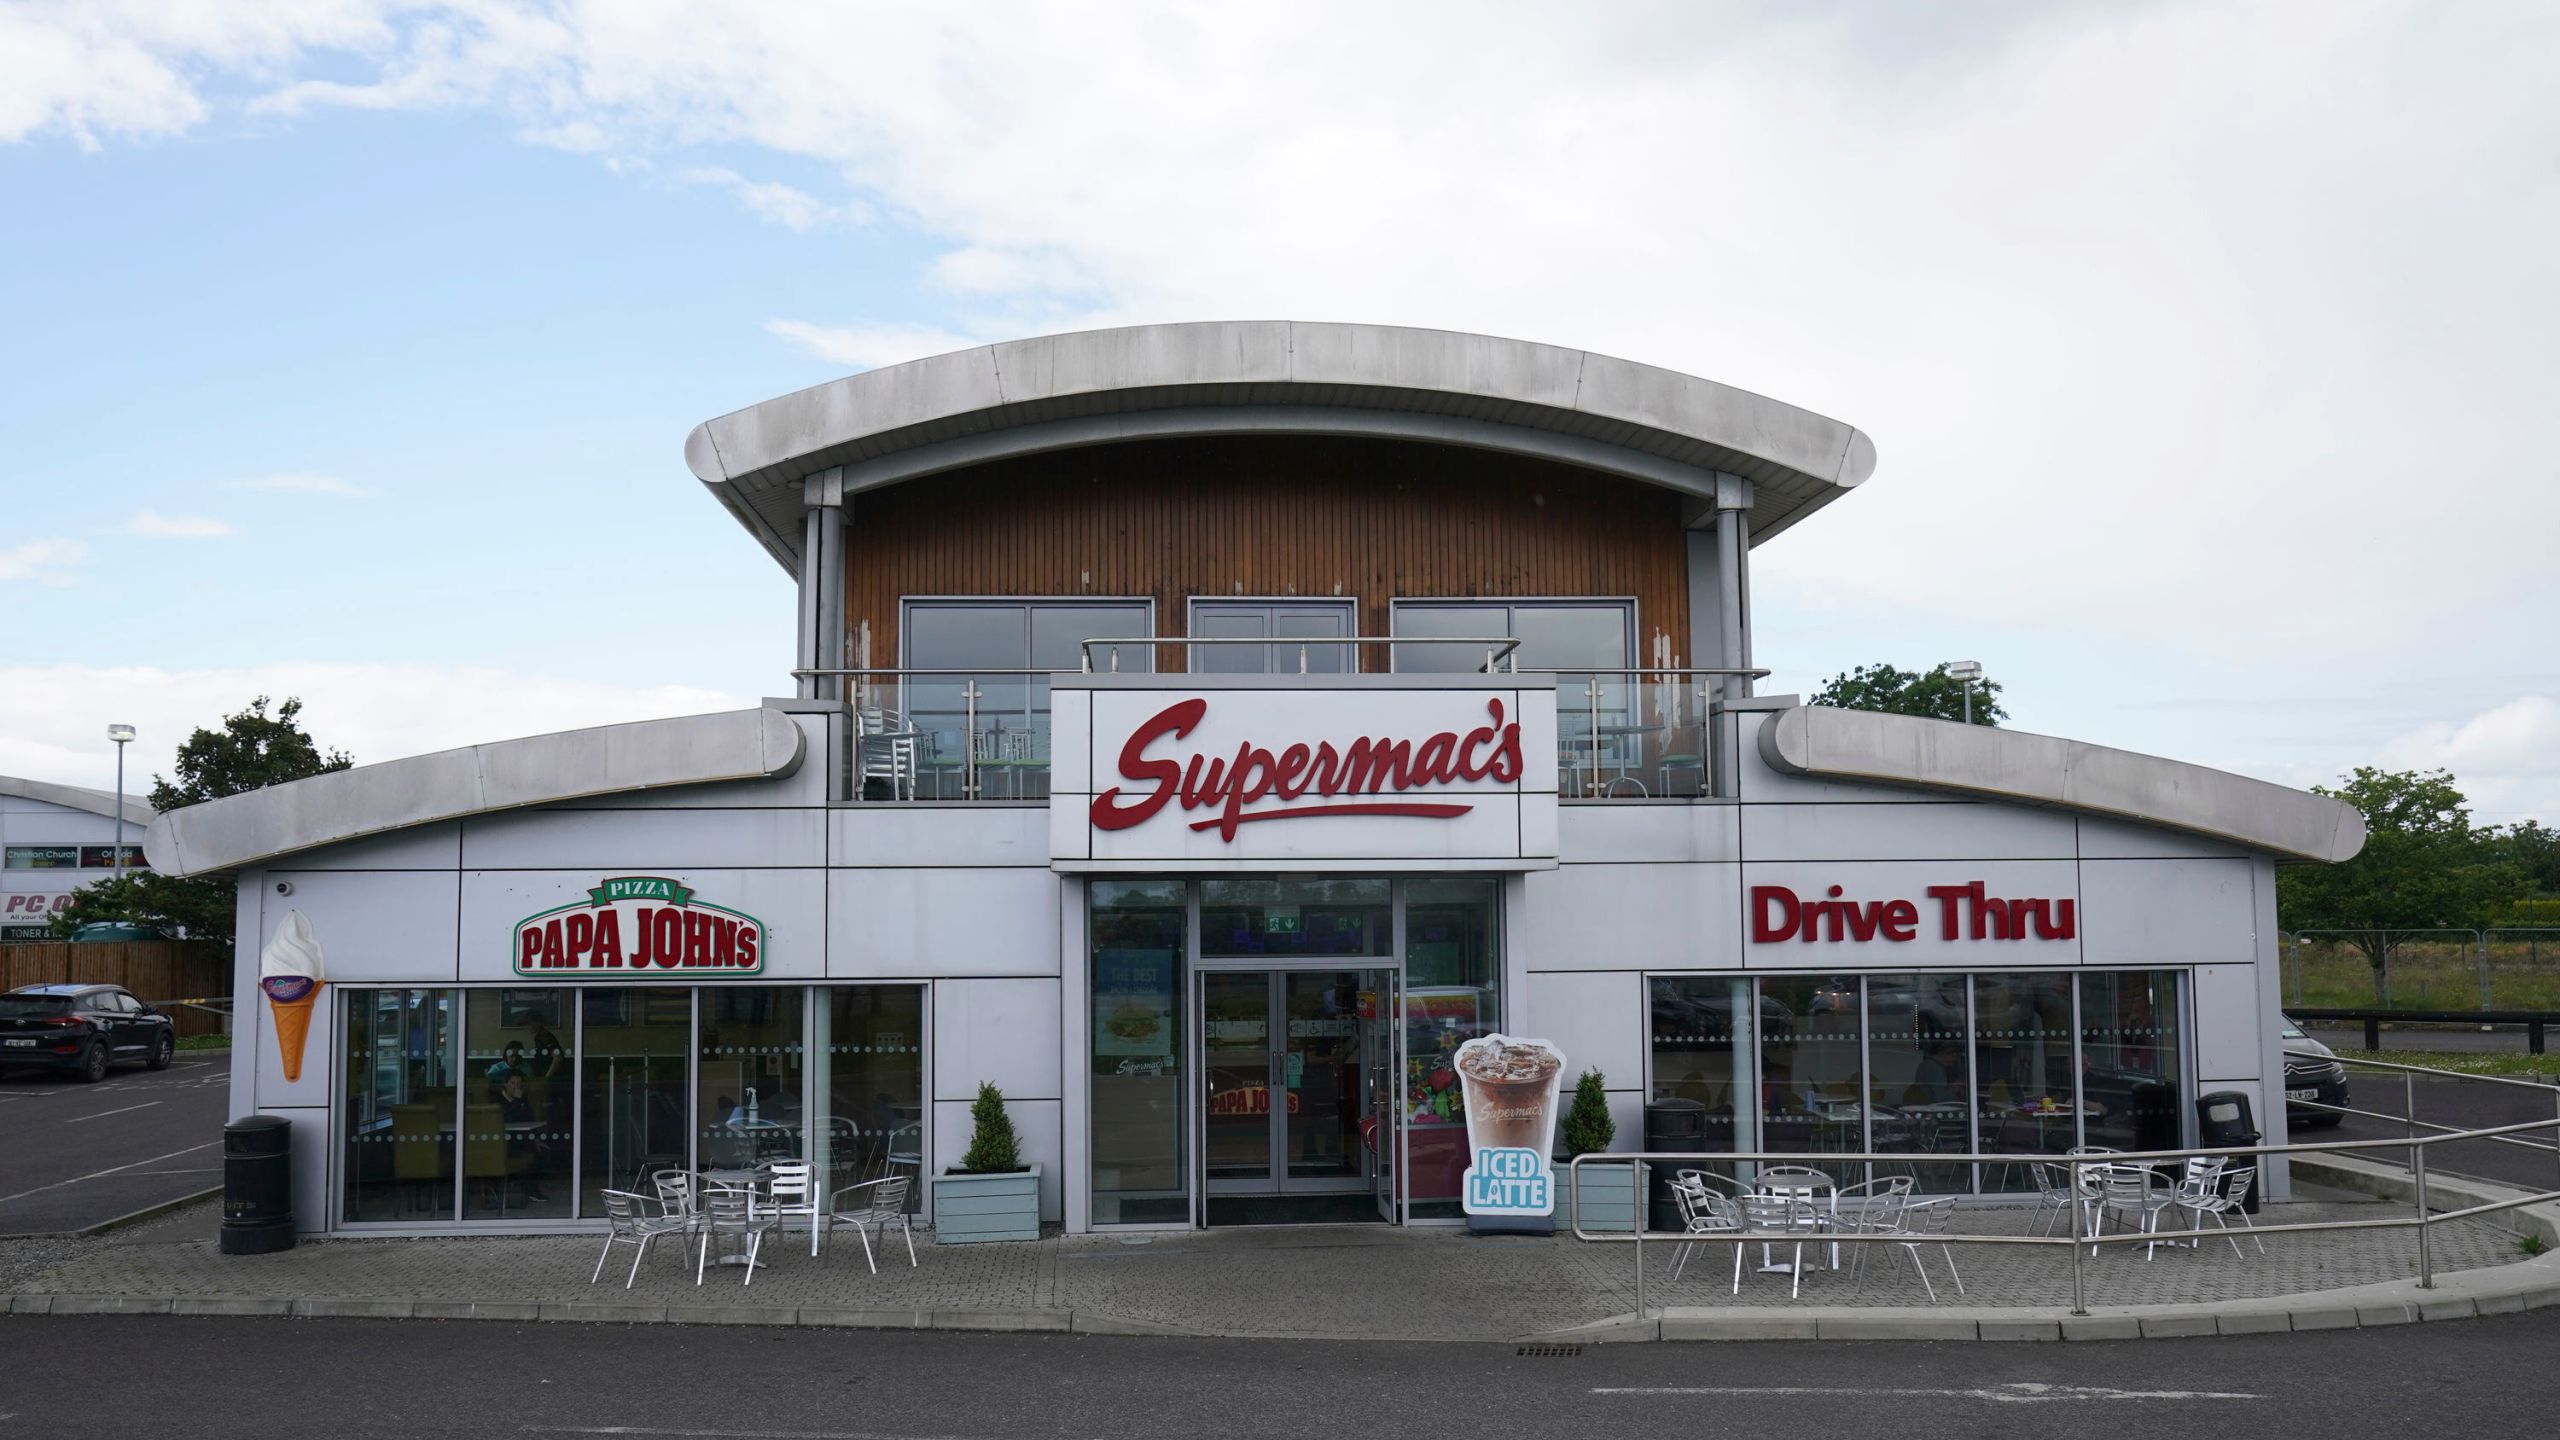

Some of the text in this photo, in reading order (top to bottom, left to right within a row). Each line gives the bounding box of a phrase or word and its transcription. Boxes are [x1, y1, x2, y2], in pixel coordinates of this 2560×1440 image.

[1091, 698, 1523, 843] Supermac's
[7, 850, 77, 859] Christian Church
[610, 881, 670, 897] PIZZA
[6, 894, 46, 913] PC
[1751, 881, 2076, 944] Drive Thru
[11, 929, 42, 939] TONER
[521, 907, 757, 969] PAPA JOHN'S
[1210, 1090, 1248, 1113] PAPA
[1482, 1152, 1536, 1178] ICED
[1472, 1179, 1544, 1206] LATTE
